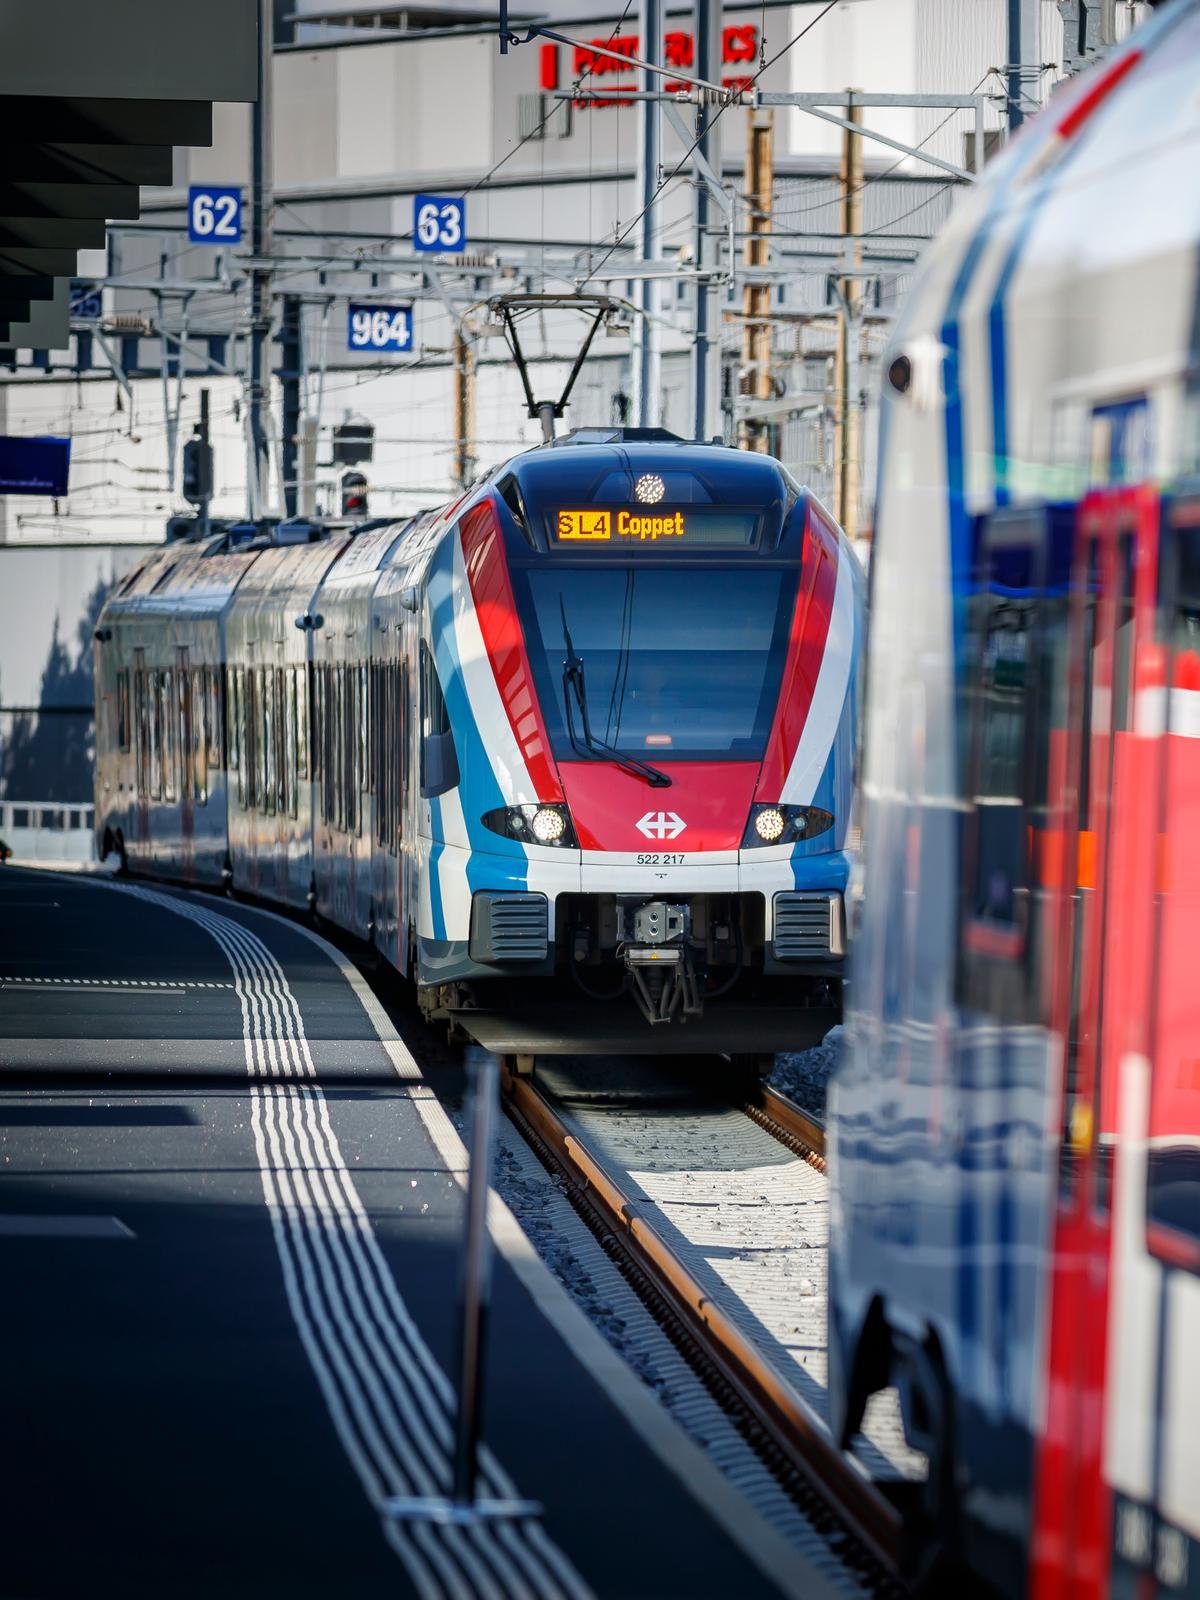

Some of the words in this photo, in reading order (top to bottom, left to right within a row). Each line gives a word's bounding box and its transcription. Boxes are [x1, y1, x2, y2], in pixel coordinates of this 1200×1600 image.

[192, 194, 238, 236] 62
[417, 203, 461, 246] 63
[352, 311, 411, 347] 964
[617, 511, 685, 540] Coppet
[637, 854, 659, 865] 522
[663, 854, 685, 865] 217
